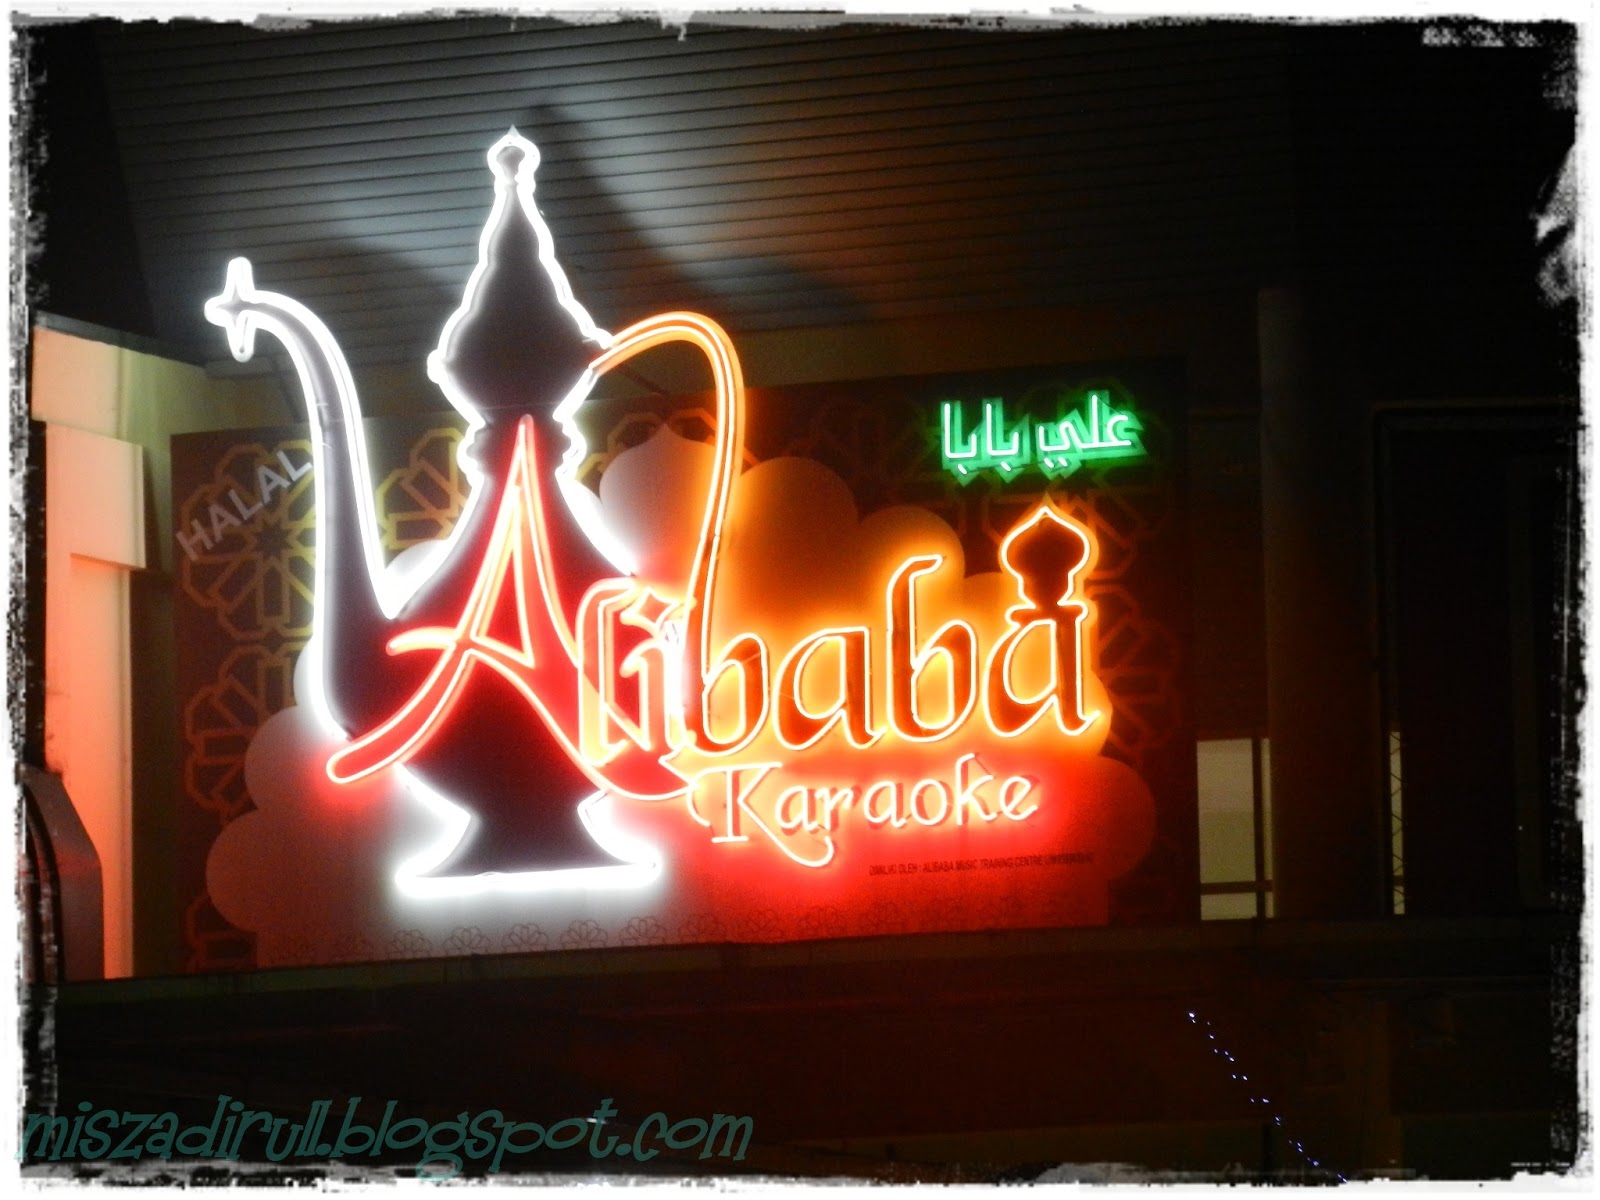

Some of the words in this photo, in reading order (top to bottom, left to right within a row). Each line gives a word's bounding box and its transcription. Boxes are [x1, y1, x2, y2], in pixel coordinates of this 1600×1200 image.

[943, 400, 1024, 480] بابا
[1037, 393, 1138, 475] علي
[175, 450, 314, 562] HALAL
[326, 414, 1102, 800] Alibaba
[686, 753, 1039, 867] Karaoke
